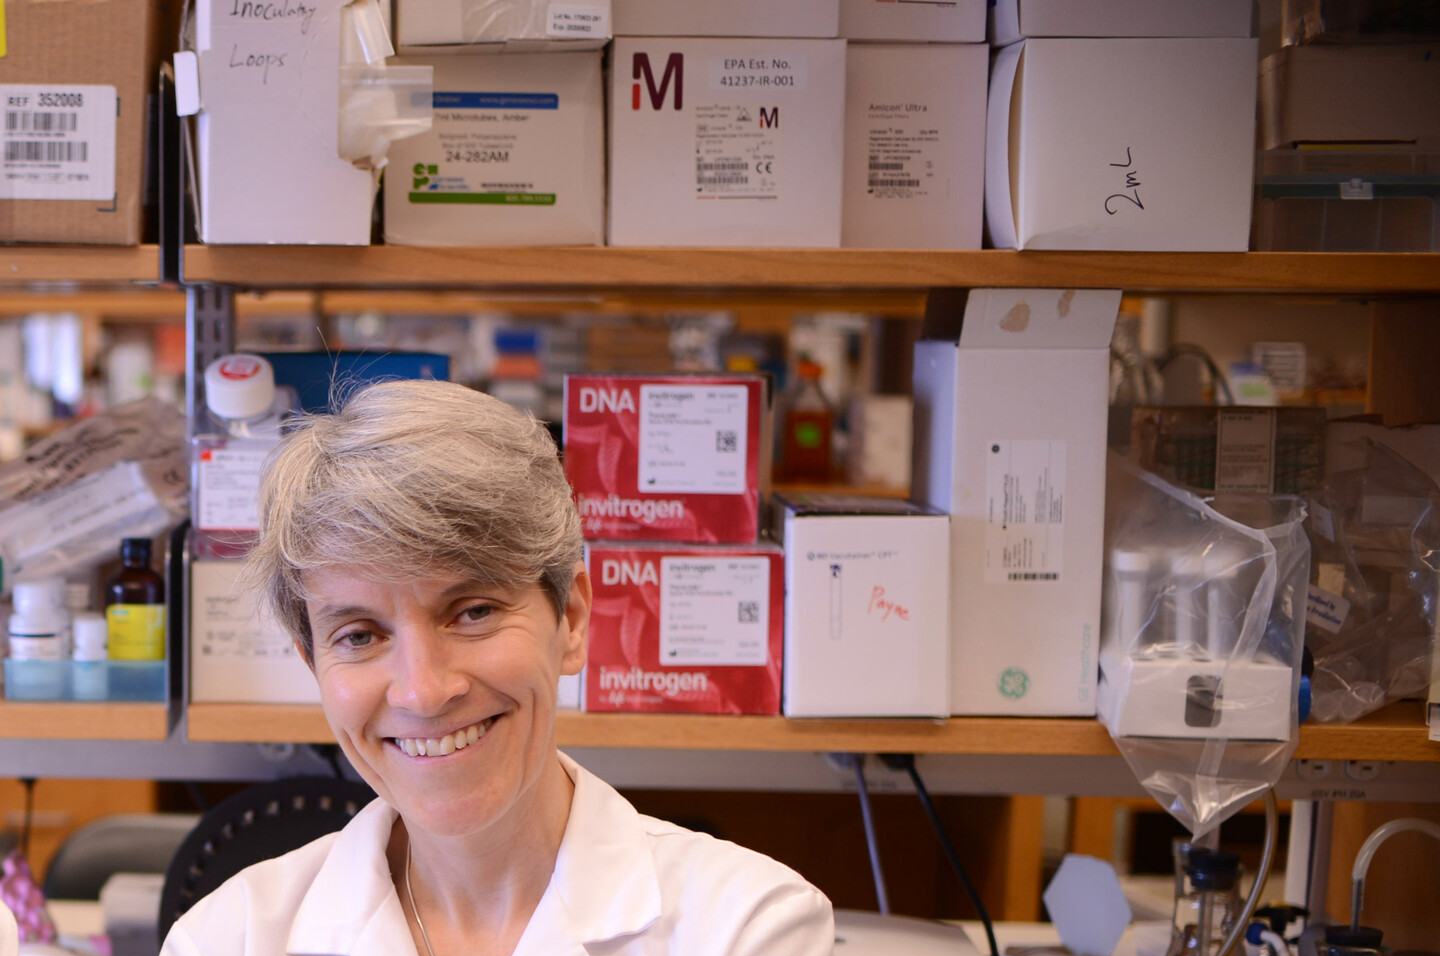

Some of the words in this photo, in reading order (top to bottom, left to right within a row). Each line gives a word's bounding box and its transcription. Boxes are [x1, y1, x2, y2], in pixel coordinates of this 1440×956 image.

[229, 44, 288, 84] Loops
[724, 59, 746, 70] EPA
[749, 59, 769, 70] Est.
[772, 59, 791, 70] No.
[720, 76, 795, 87] 41237-IR-001
[37, 92, 84, 107] 352008
[905, 104, 928, 112] Ultra
[445, 151, 509, 163] 24-282AM
[580, 387, 636, 414] DNA
[578, 493, 684, 524] invitrogen
[602, 559, 658, 585] DNA
[866, 585, 911, 624] Payne
[599, 666, 707, 696] invitrogen
